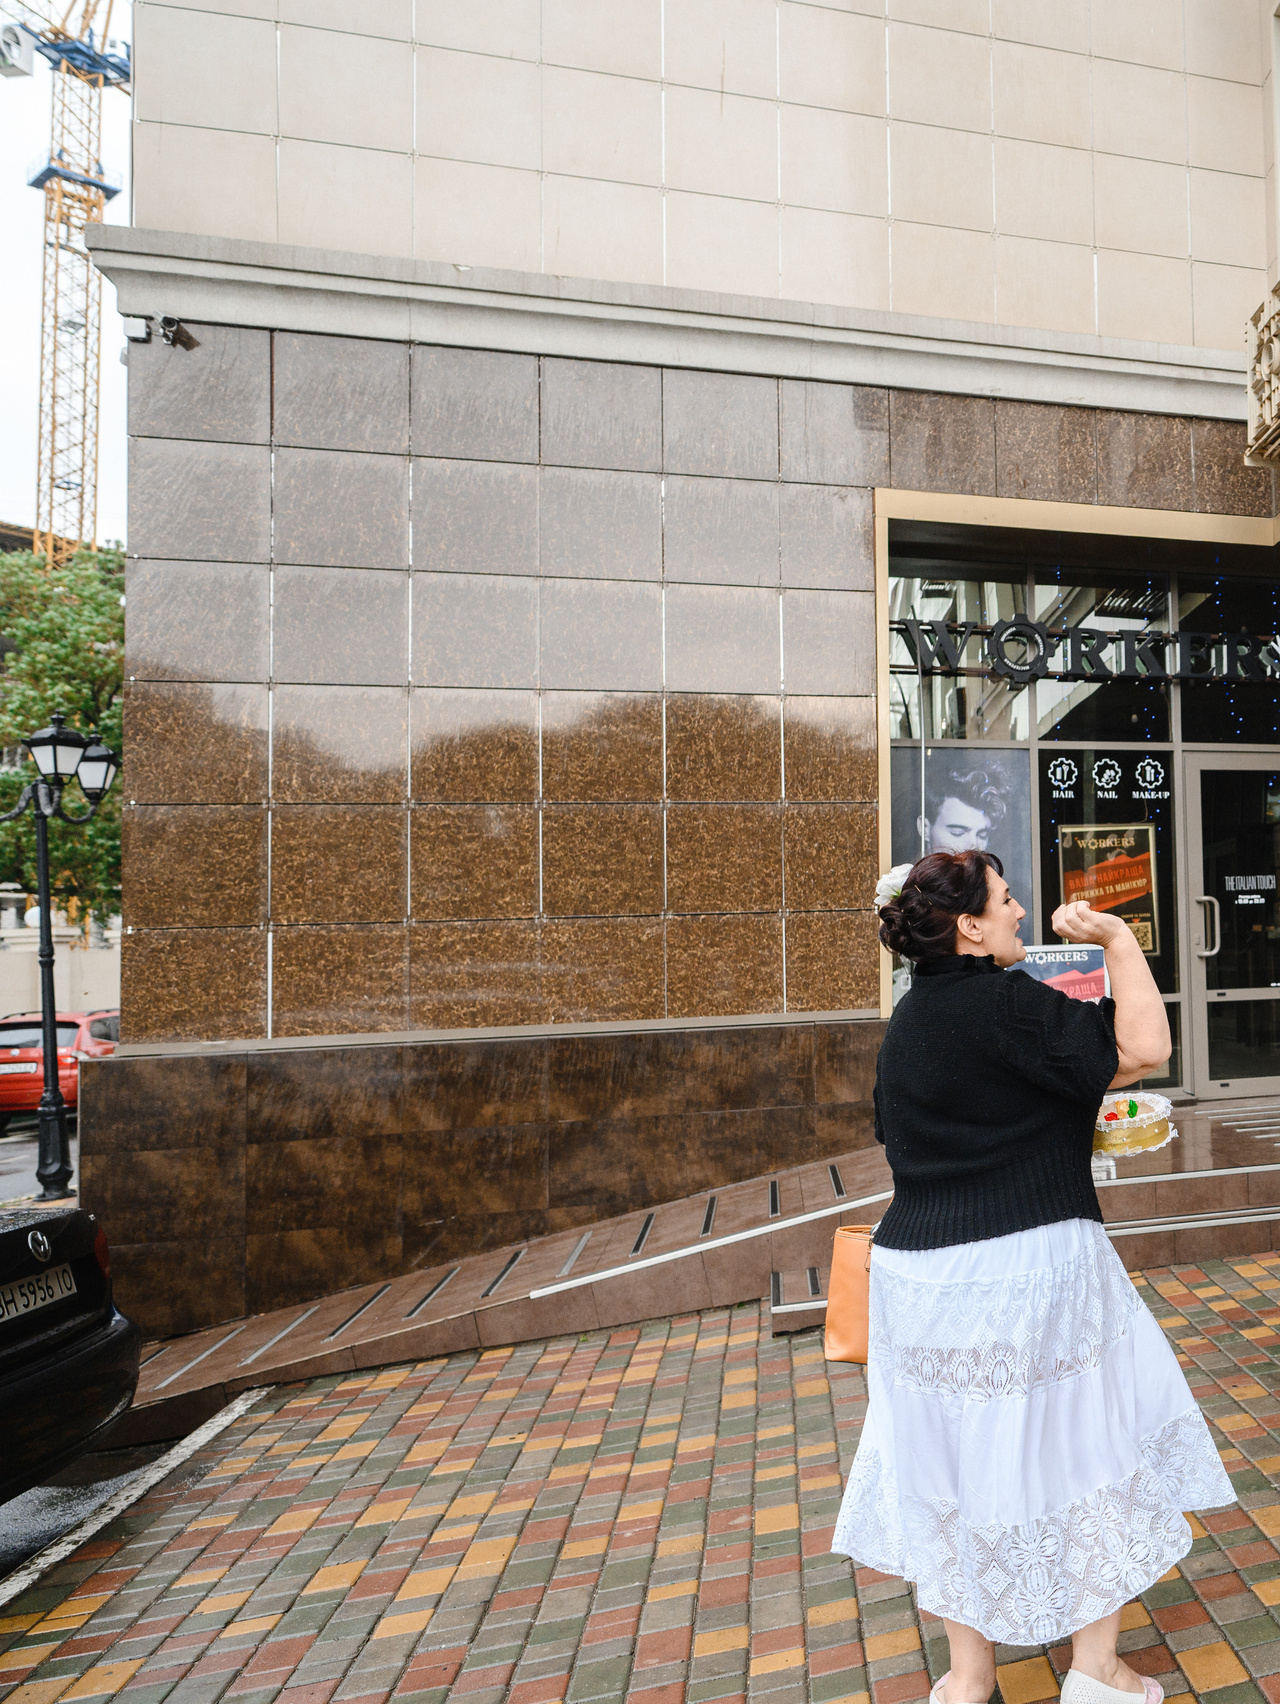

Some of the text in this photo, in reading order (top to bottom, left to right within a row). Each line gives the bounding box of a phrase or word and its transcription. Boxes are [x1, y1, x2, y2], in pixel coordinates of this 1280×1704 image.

[1052, 790, 1075, 799] HAIR
[1097, 790, 1118, 799] NAIL
[1132, 790, 1170, 799] MAKE-UP
[1076, 837, 1135, 850] WORKERS
[1069, 865, 1144, 890] ВАША НАЙКРАЩА
[1225, 875, 1276, 891] THE ITALIAN TOUCH
[1072, 878, 1147, 901] СТРИЖКА ТА МАНІКЮР
[1025, 951, 1088, 964] WORKERS
[18, 1274, 54, 1308] 5956
